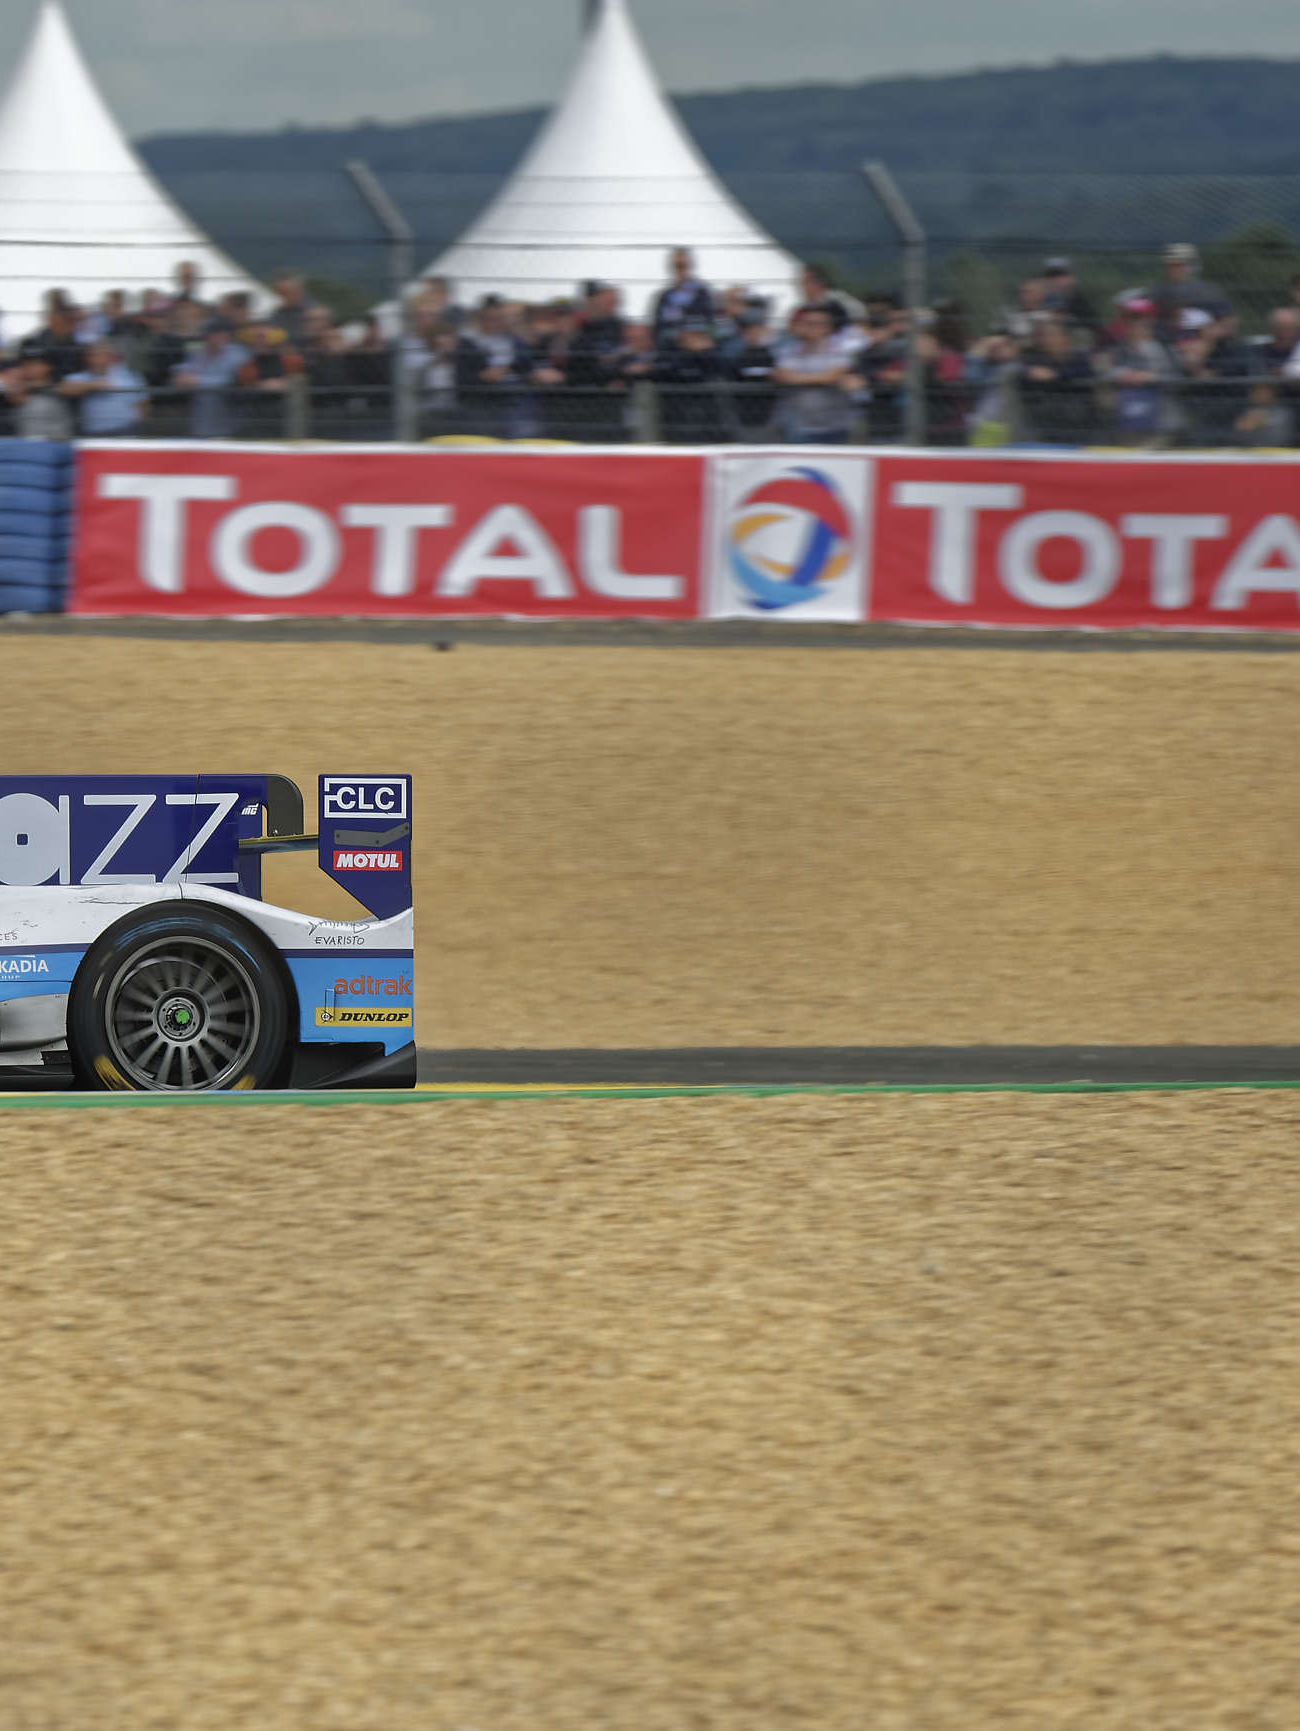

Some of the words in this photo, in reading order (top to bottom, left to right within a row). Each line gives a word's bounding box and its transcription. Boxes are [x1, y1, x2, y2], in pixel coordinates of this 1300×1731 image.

[96, 473, 685, 599] TOTAL
[336, 852, 400, 868] MOTUL
[315, 935, 365, 945] EVARISTO
[334, 975, 413, 996] adtrak
[339, 1012, 410, 1022] DUNLOP
